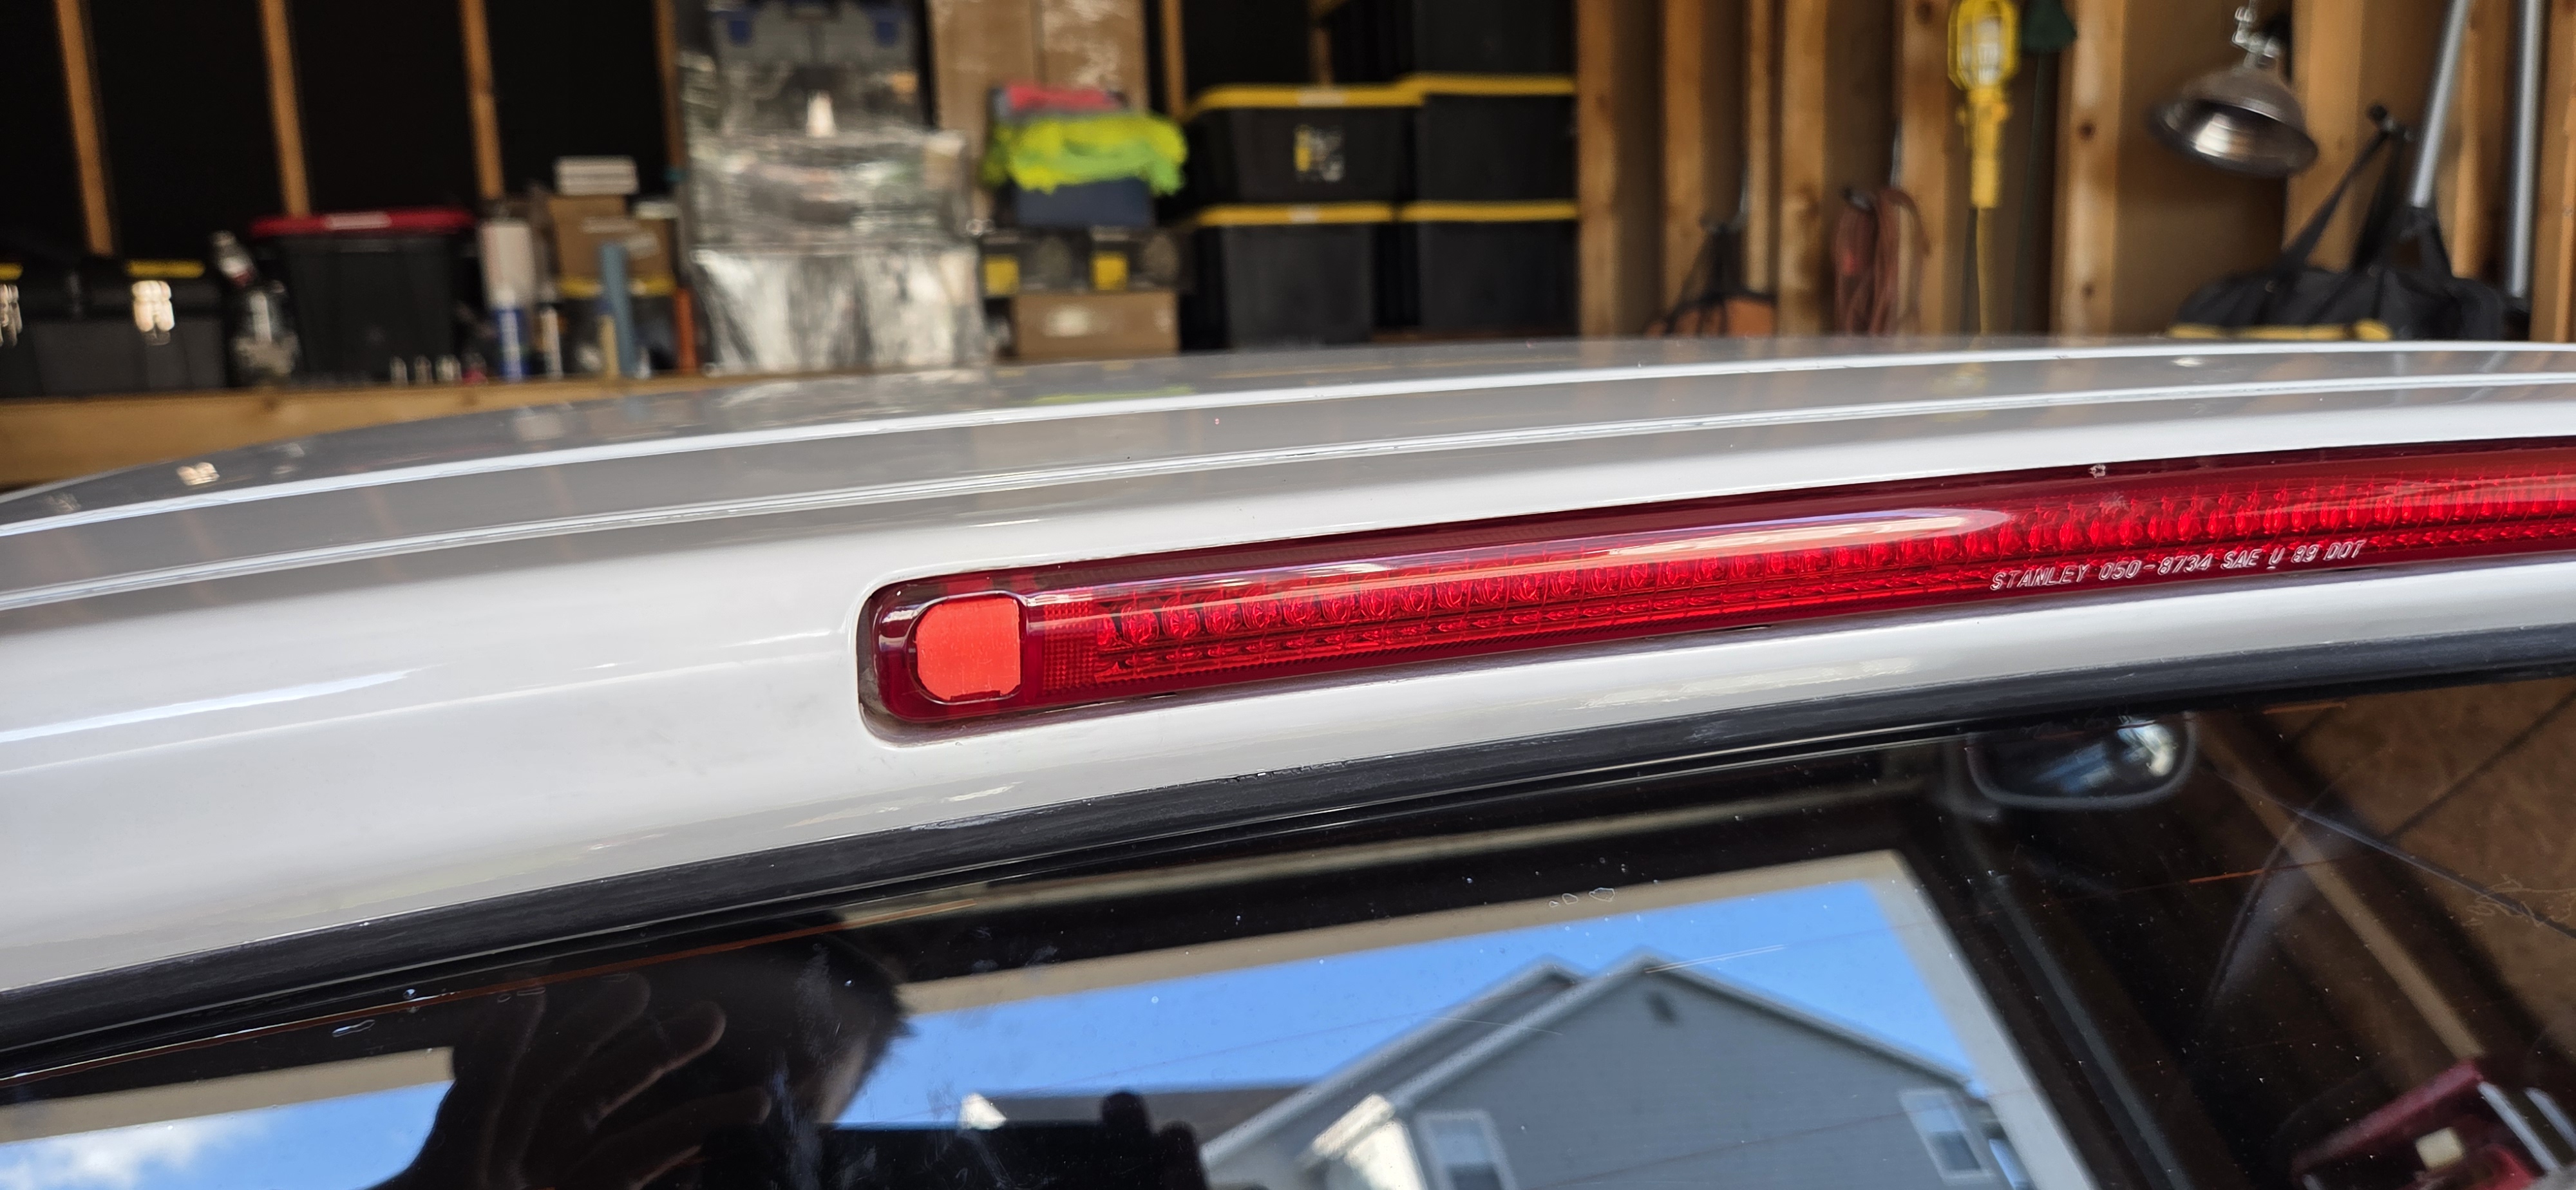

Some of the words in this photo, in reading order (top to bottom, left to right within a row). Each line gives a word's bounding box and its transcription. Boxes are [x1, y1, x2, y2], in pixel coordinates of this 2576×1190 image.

[1990, 564, 2090, 590] STANLEY
[2099, 552, 2214, 580] 050-8734
[2220, 549, 2262, 569] SAE
[2291, 544, 2320, 563] 89
[2323, 539, 2367, 561] DOT
